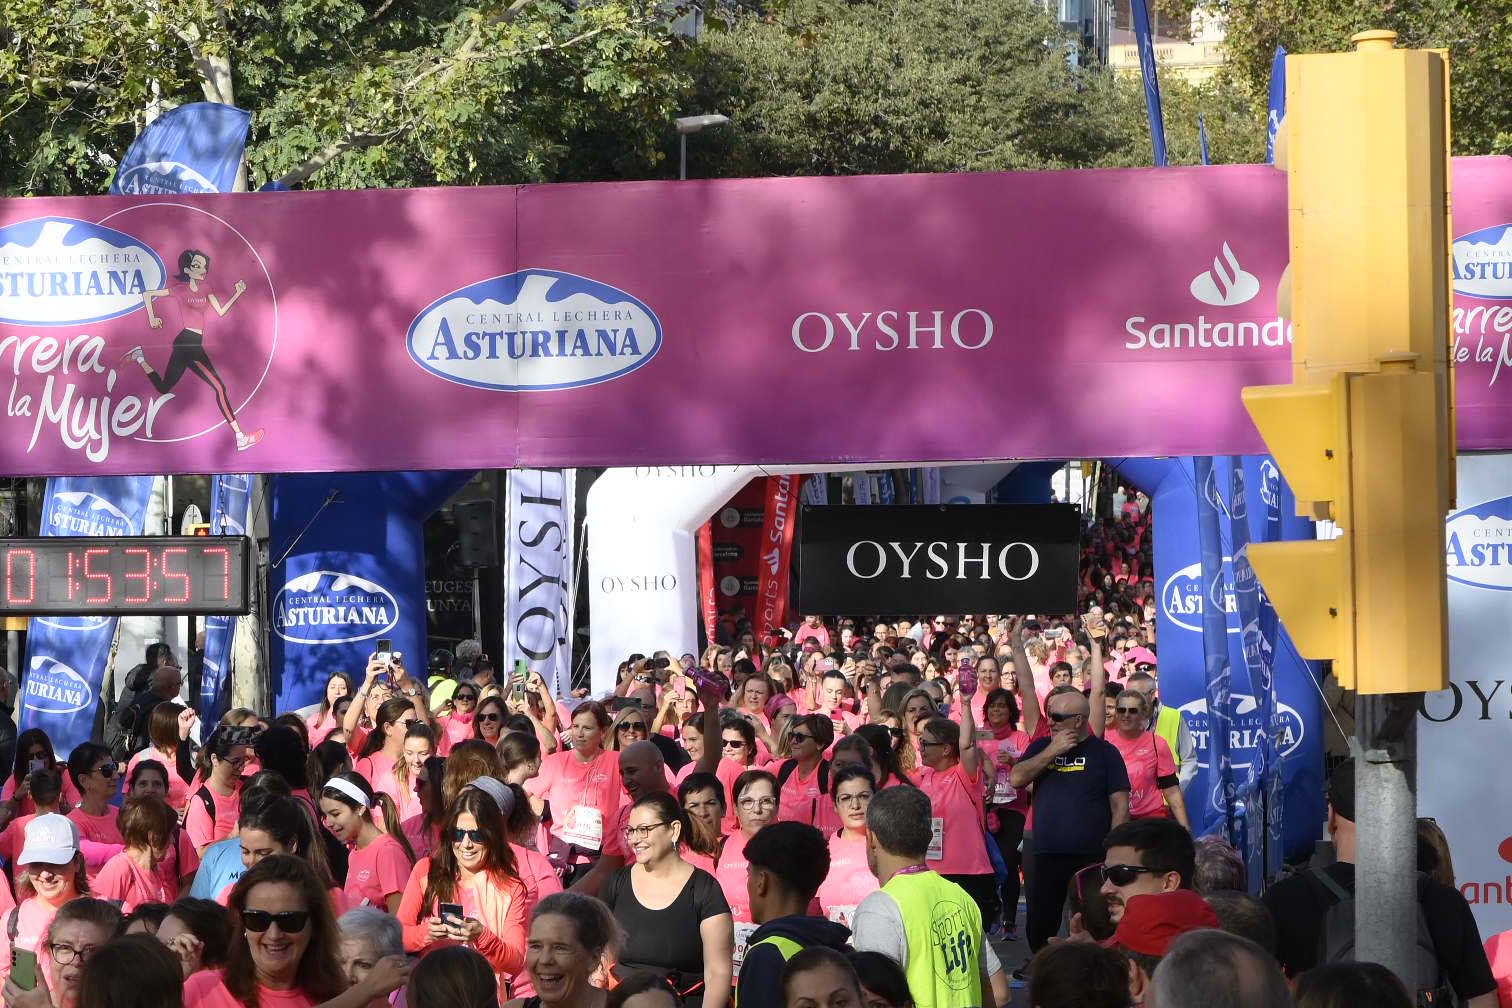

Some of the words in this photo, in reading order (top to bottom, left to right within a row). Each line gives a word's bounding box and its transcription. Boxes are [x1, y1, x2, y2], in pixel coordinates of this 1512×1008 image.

[67, 252, 142, 265] LECHERA
[466, 312, 545, 326] CENTRAL
[551, 309, 634, 323] LECHERA
[791, 308, 995, 353] OYSHO
[427, 316, 642, 361] ASTURIANA
[7, 379, 32, 417] la
[27, 369, 176, 463] Mujer
[6, 548, 231, 604] 01:53:57
[846, 540, 1040, 581] OYSHO
[287, 596, 332, 604] CENTRAL
[334, 595, 385, 605] LECHERA
[601, 573, 677, 595] OYSHO
[276, 601, 390, 627] ASTURIANA
[932, 908, 967, 947] Sport
